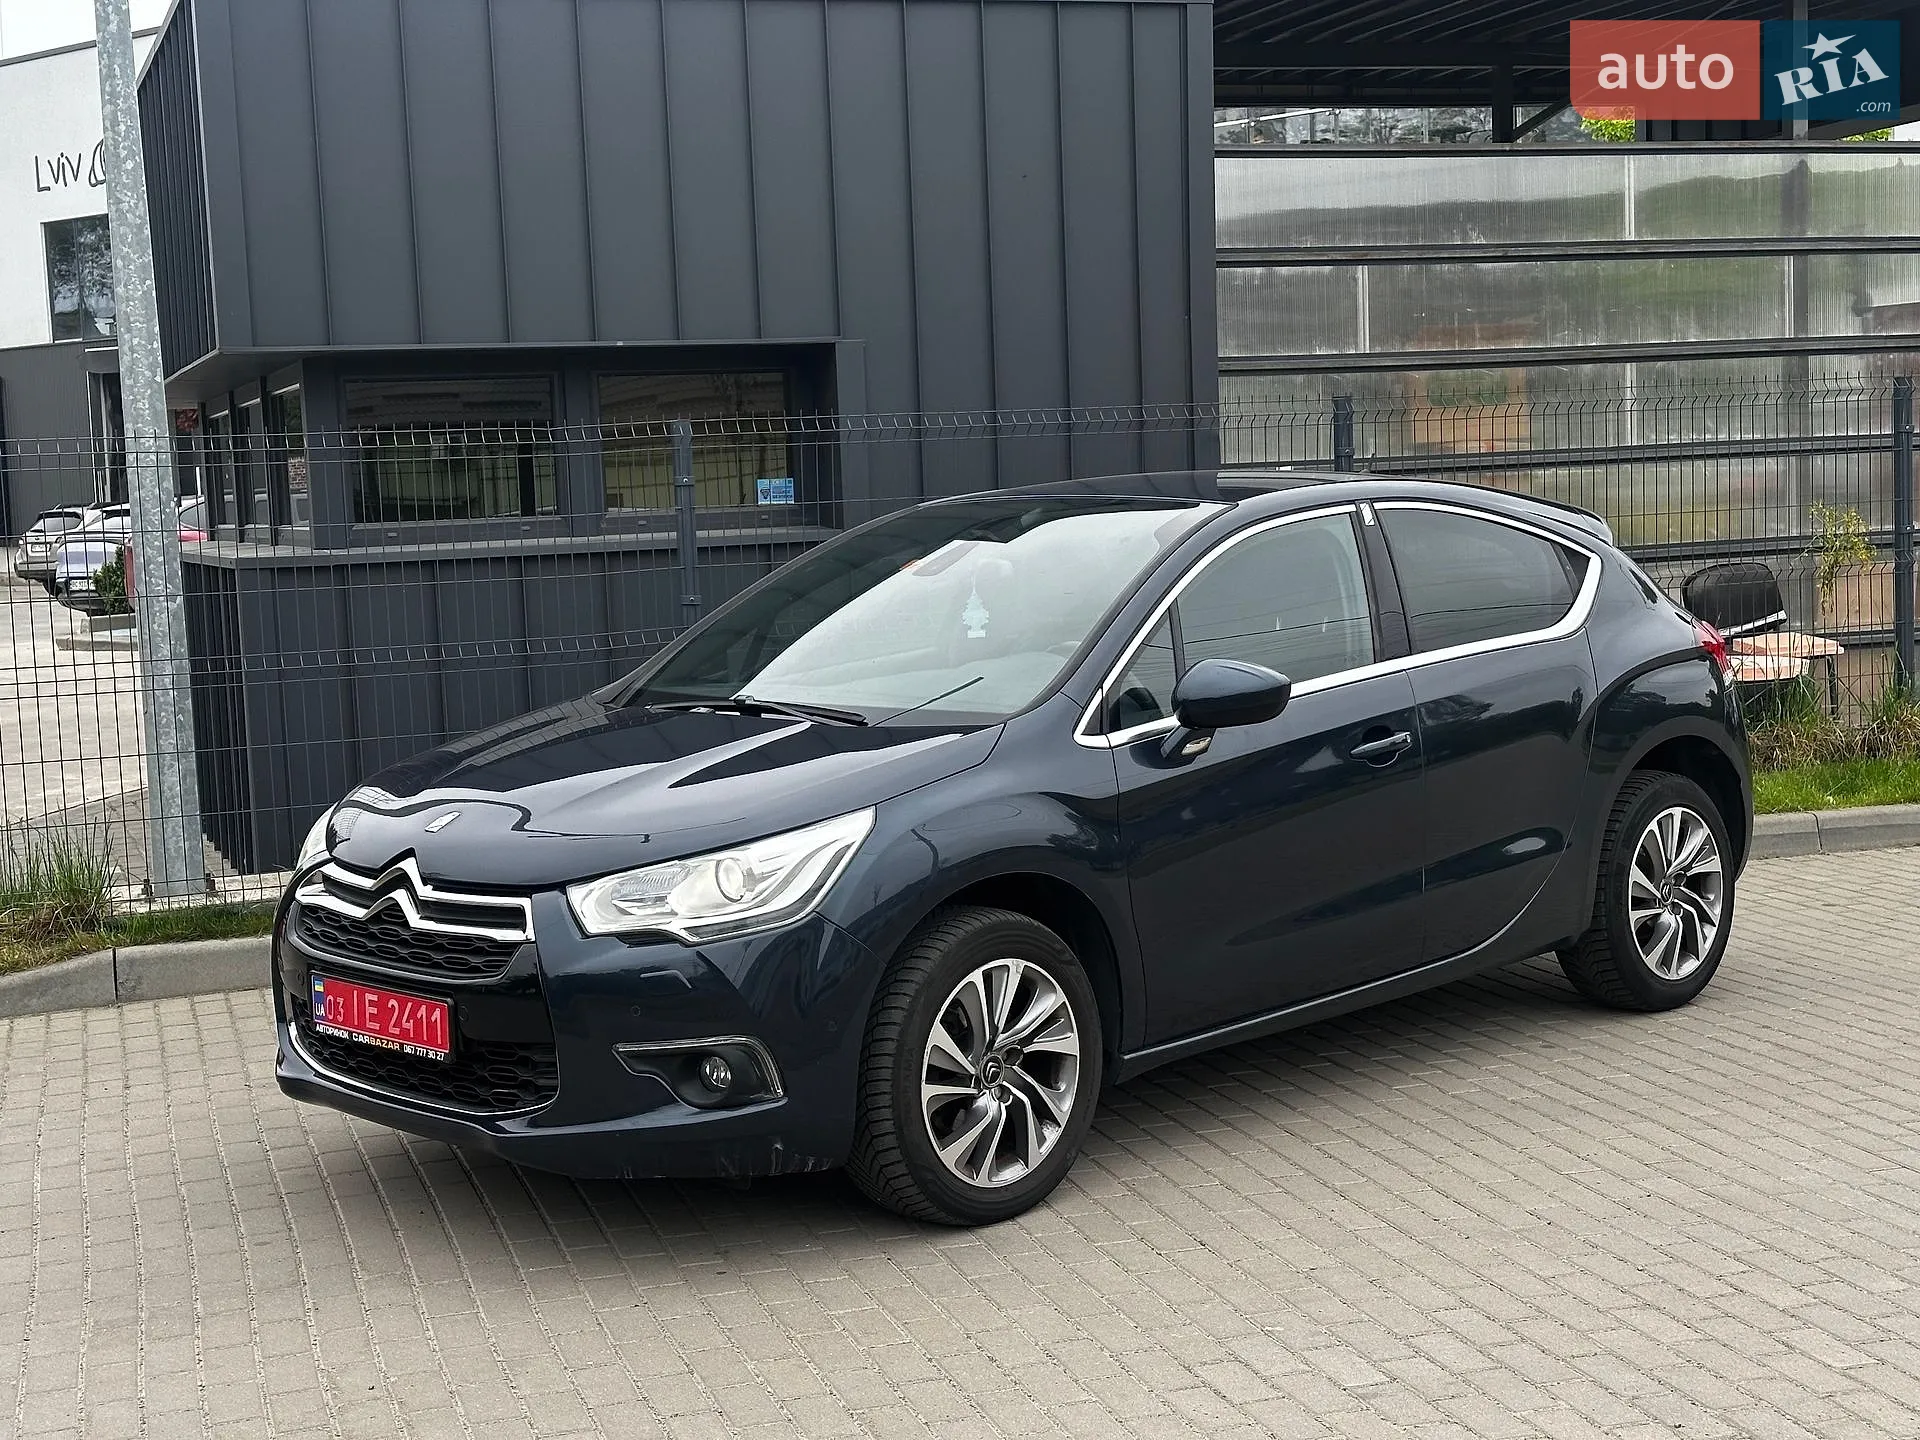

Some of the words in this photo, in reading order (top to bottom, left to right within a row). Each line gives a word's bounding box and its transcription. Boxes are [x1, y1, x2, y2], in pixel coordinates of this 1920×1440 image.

[35, 152, 82, 193] Lviv
[315, 1002, 325, 1017] UA
[326, 994, 345, 1023] 03
[353, 989, 381, 1031] IE
[388, 998, 442, 1045] 2411
[352, 1032, 401, 1051] CARBAZAR
[403, 1043, 415, 1055] 067
[415, 1046, 427, 1058] 777
[427, 1049, 436, 1060] 30
[436, 1051, 445, 1061] 27
